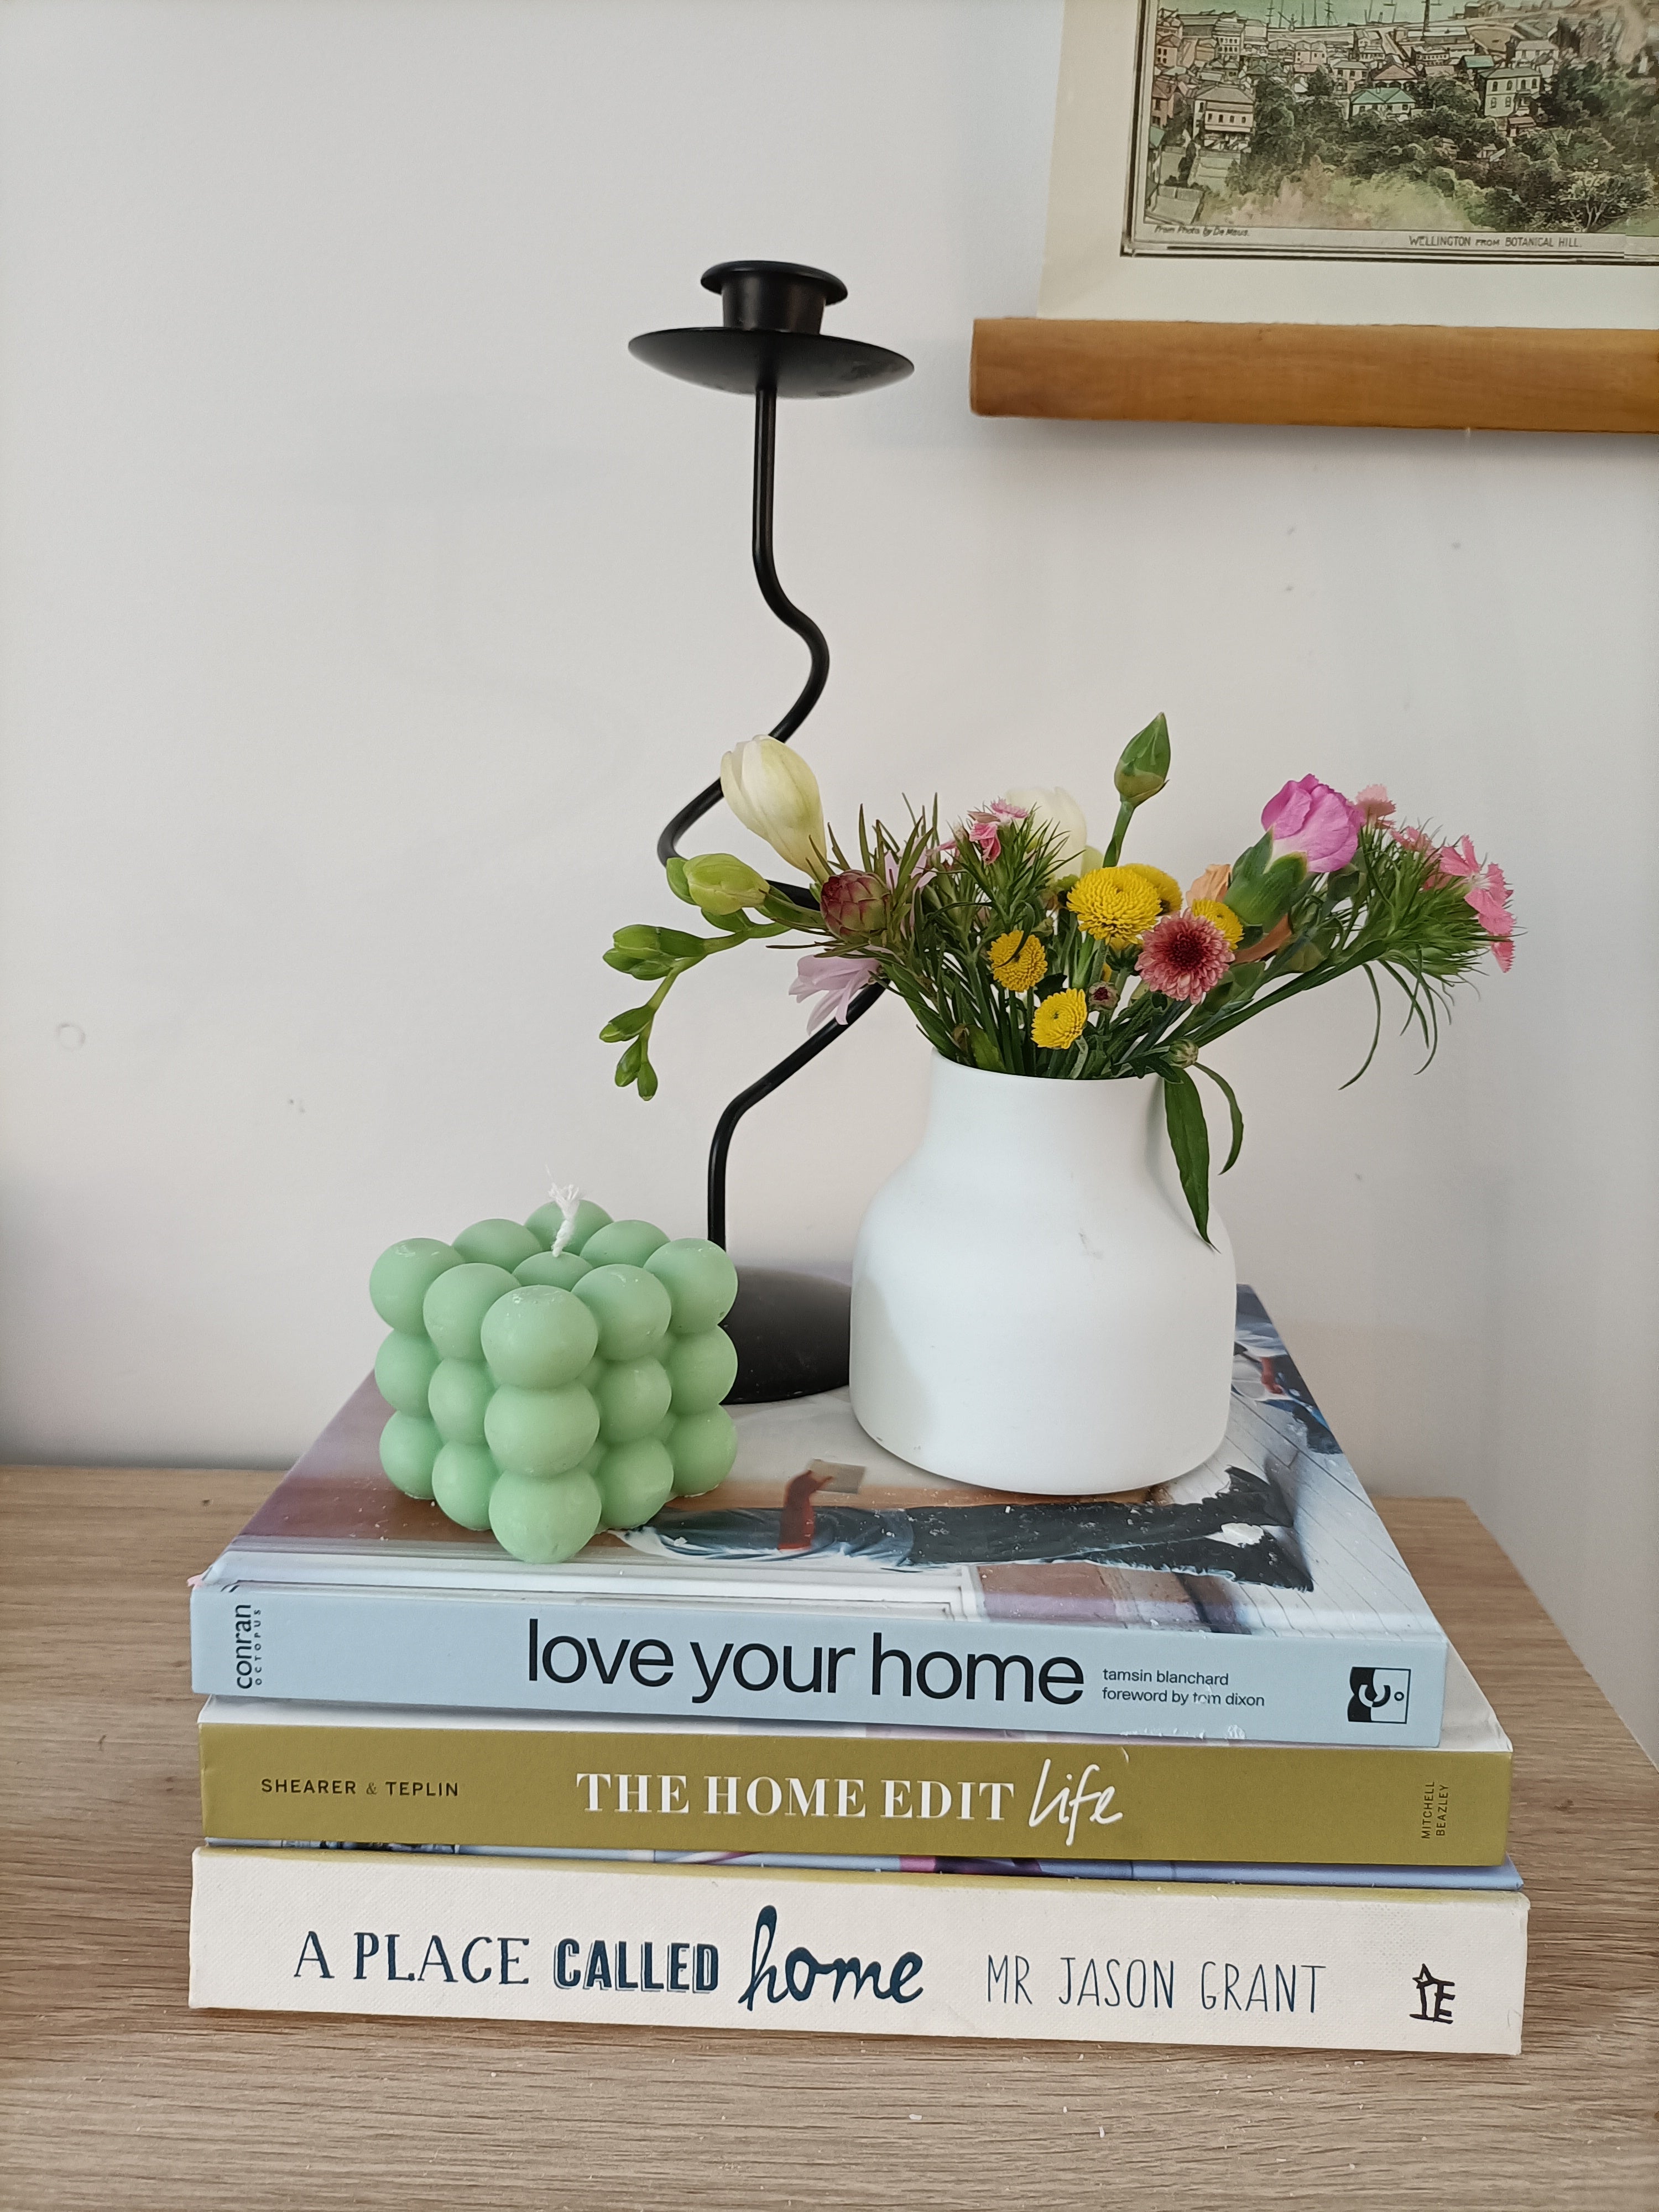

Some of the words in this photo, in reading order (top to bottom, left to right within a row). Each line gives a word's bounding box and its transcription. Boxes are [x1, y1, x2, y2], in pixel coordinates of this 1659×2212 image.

[1177, 226, 1199, 234] Photo
[1202, 226, 1212, 237] by
[1409, 236, 1470, 247] WELLINGTON
[1505, 237, 1553, 247] BOTANICAL
[1558, 238, 1582, 248] HILL.
[235, 1604, 253, 1689] conran
[529, 1618, 674, 1687] love
[690, 1641, 855, 1704] your
[872, 1632, 1084, 1705] home
[1102, 1687, 1167, 1702] foreword
[1171, 1690, 1189, 1706] by
[1225, 1693, 1265, 1707] dixon
[1103, 1668, 1152, 1682] tamsin
[1156, 1670, 1229, 1686] blanchard
[261, 1778, 356, 1794] SHEARER
[366, 1782, 377, 1796] &
[385, 1781, 458, 1797] TEPLIN
[576, 1773, 689, 1814] THE
[703, 1776, 866, 1818] HOME
[880, 1780, 1014, 1821] EDIT
[1421, 1781, 1435, 1839] MITCHELL
[1436, 1784, 1449, 1836] BEAZLEY
[294, 1931, 335, 1978] A
[353, 1932, 529, 1984] PLACE
[554, 1938, 719, 1994] CALLED
[738, 1905, 924, 2011] home
[988, 1954, 1032, 2005] MR
[1059, 1957, 1174, 2008] JASON
[1201, 1961, 1326, 2013] GRANT
